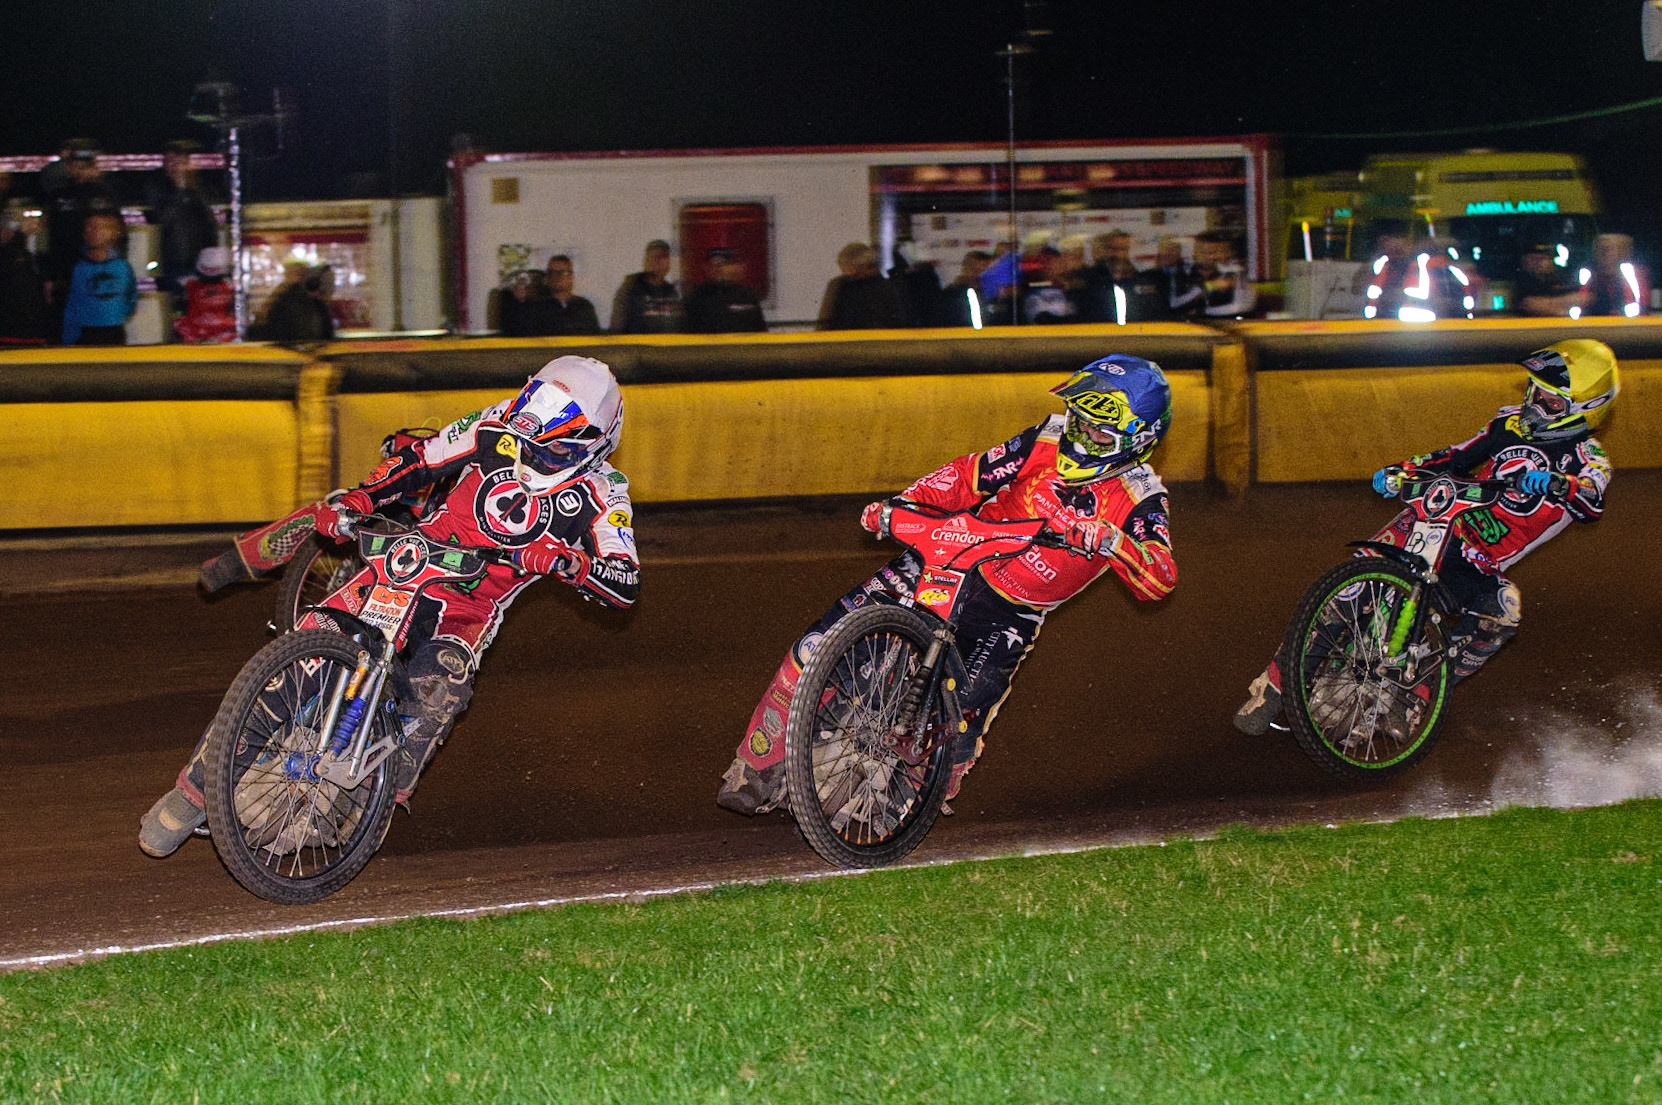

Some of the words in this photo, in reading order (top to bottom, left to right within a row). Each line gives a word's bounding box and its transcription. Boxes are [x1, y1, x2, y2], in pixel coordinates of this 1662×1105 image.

[1465, 201, 1558, 215] AMBULANCE
[513, 416, 538, 431] STS
[539, 498, 547, 524] ACES
[1033, 493, 1077, 529] PANTHER
[931, 528, 985, 544] Crendon
[1017, 555, 1050, 585] NGINEERING
[360, 610, 402, 625] PREMIER
